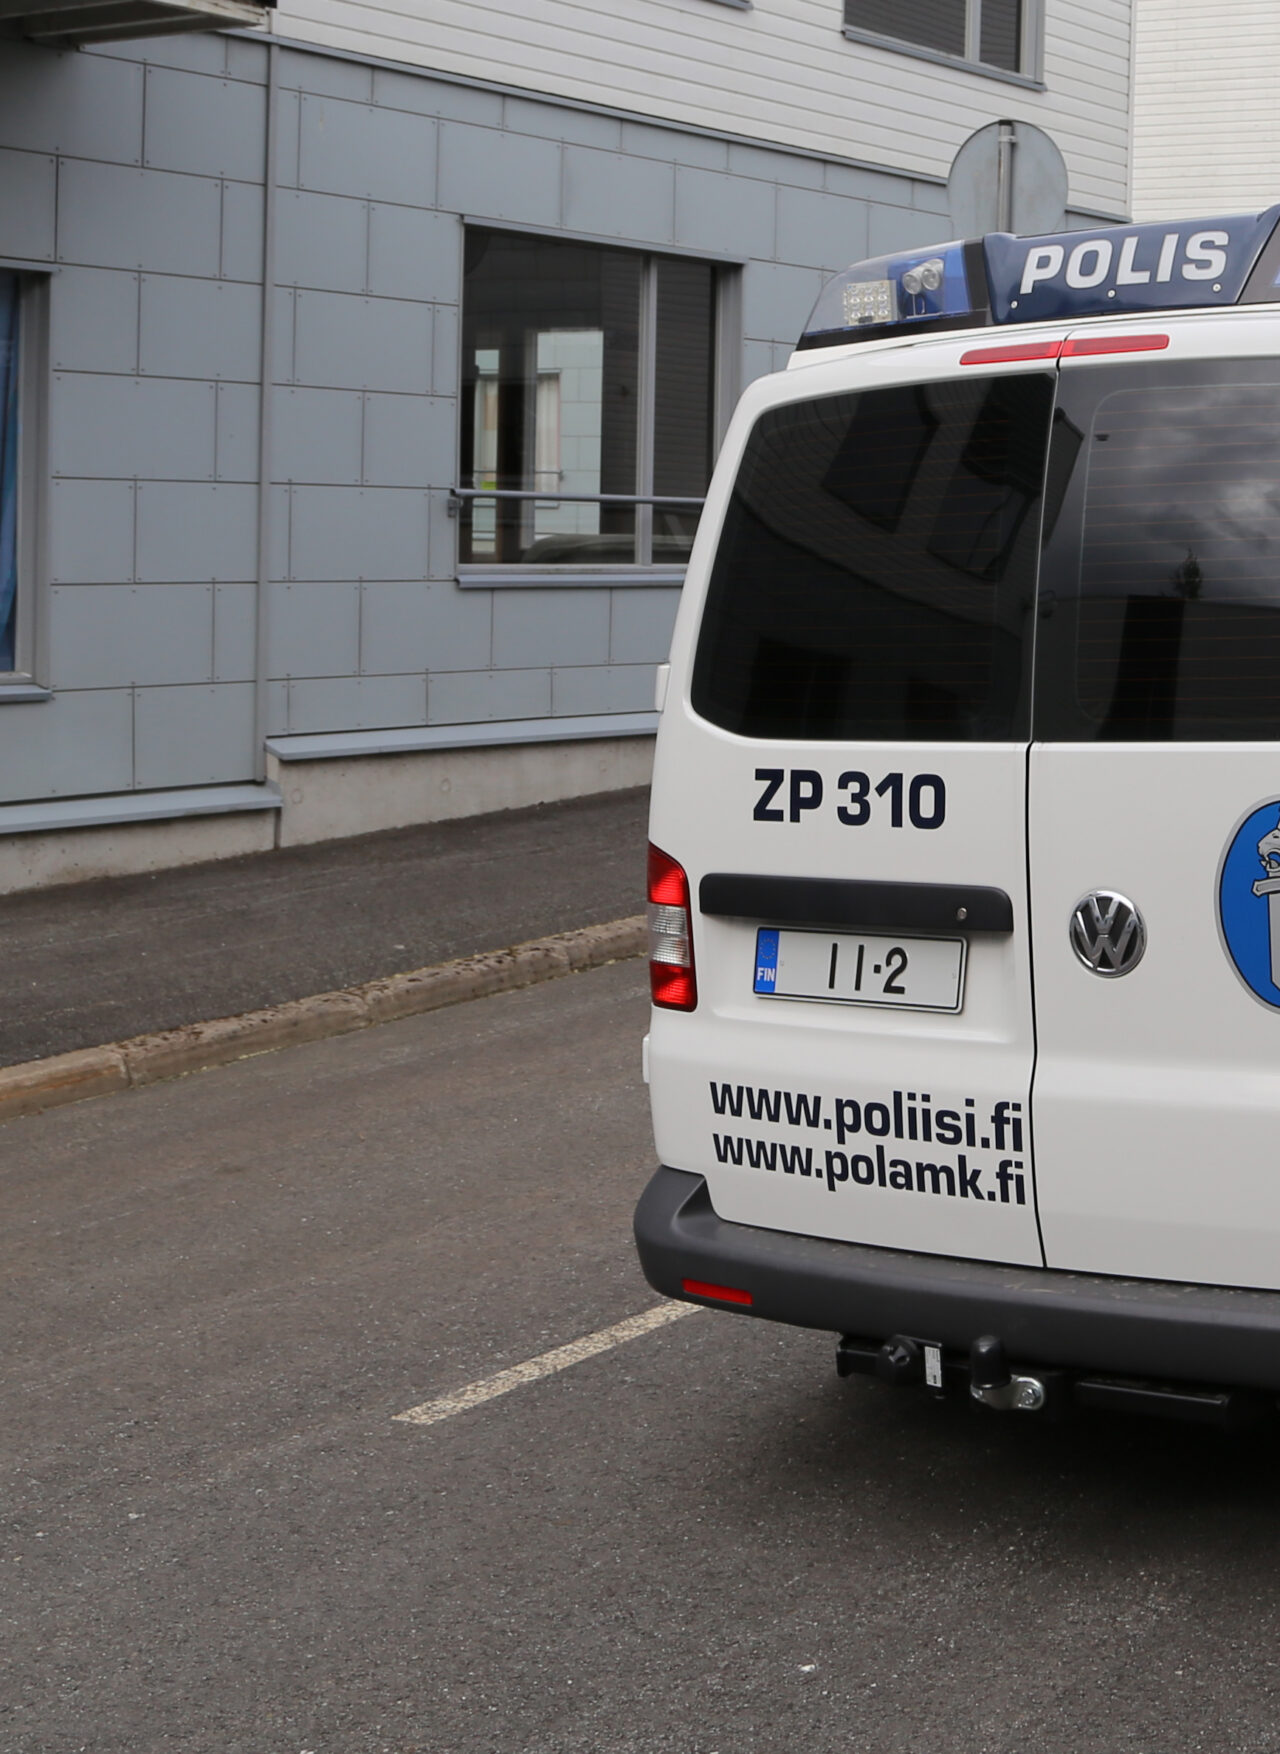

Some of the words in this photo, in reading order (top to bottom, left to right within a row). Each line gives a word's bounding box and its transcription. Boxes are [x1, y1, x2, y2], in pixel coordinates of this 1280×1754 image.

[1020, 230, 1229, 295] POLIS
[753, 768, 823, 823] ZP
[836, 770, 946, 830] 310
[757, 966, 776, 982] FIN
[709, 1081, 1024, 1152] www.poliisi.fi
[713, 1133, 1026, 1205] www.polamk.fi
